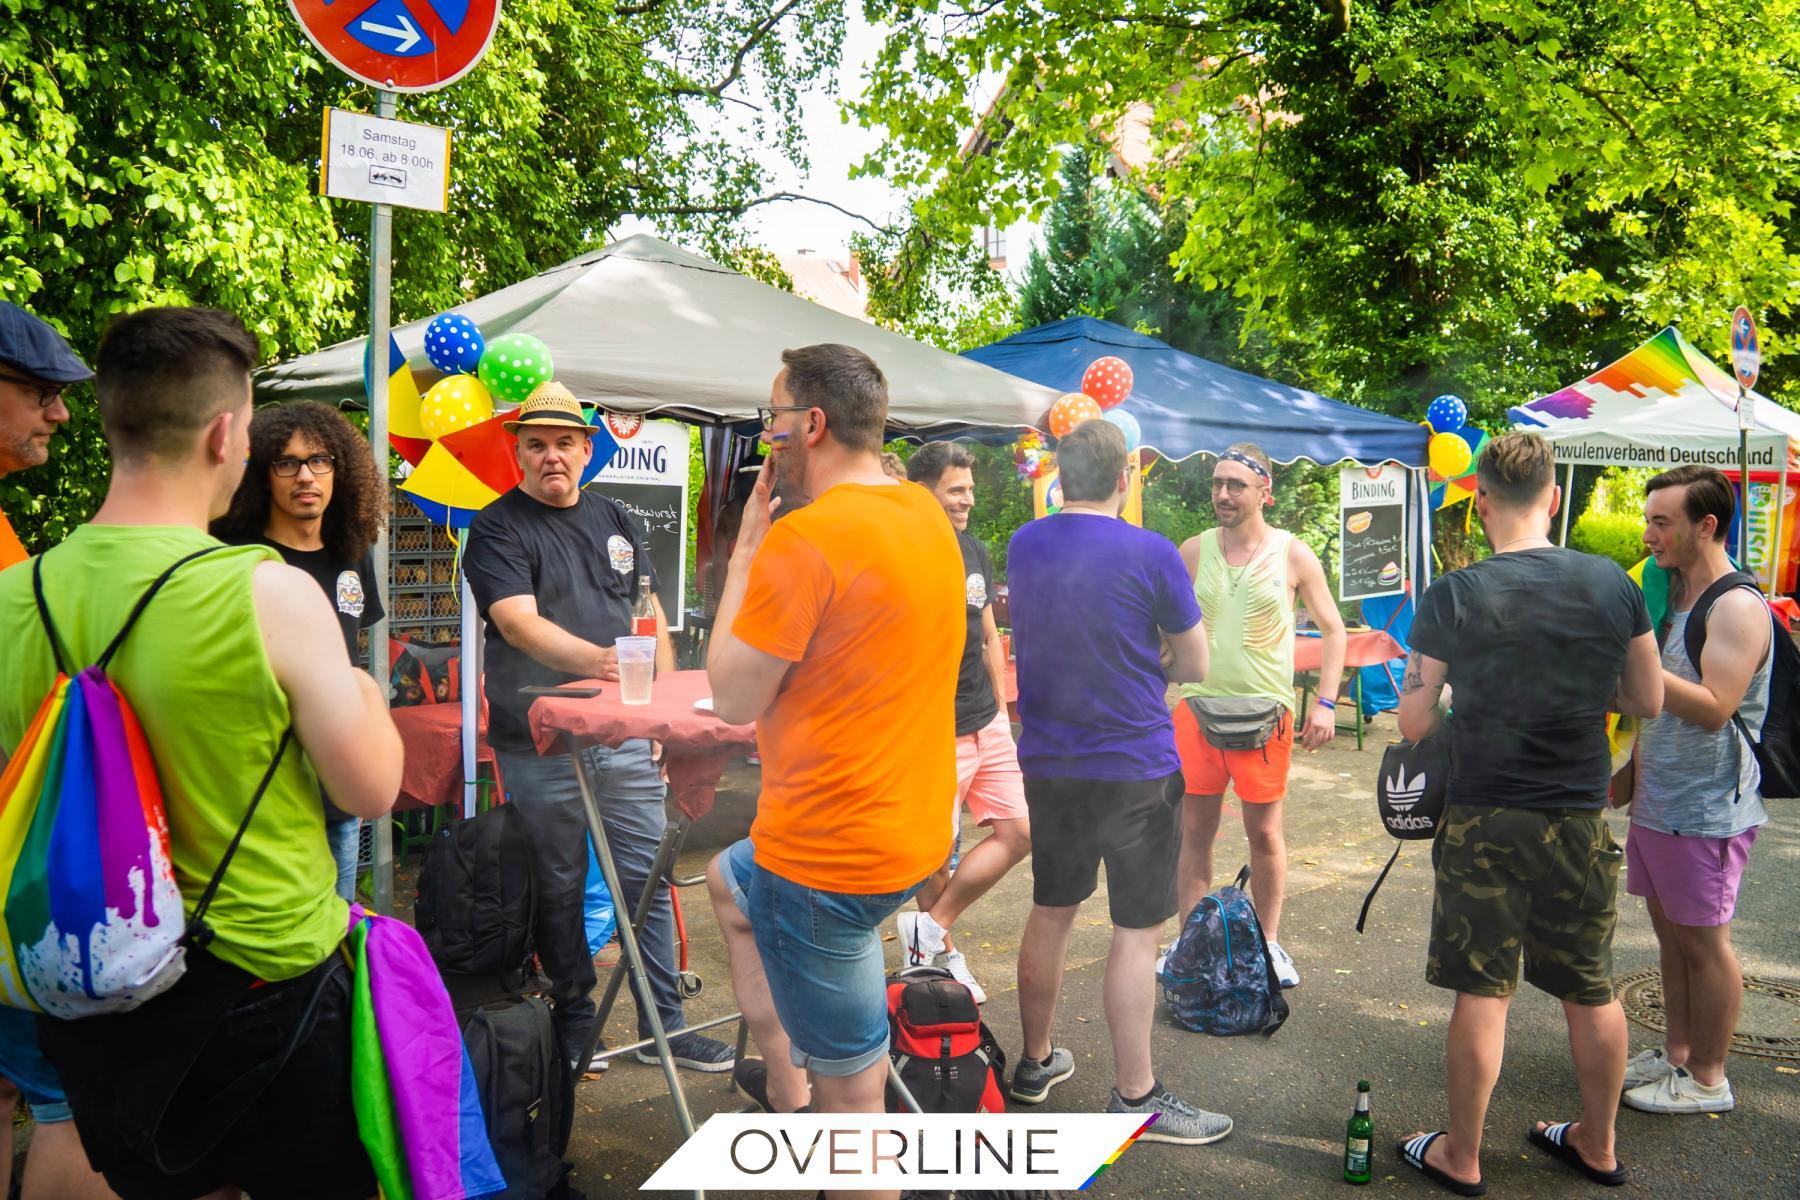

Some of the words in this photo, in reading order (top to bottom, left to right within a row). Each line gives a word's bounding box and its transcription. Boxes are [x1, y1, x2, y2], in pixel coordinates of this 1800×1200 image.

[363, 128, 416, 150] Samstag
[340, 143, 378, 161] 18.06.
[382, 152, 397, 163] ab
[609, 445, 667, 473] DING
[1553, 441, 1665, 463] hwulenverband
[1670, 446, 1773, 465] Deutschlnd
[1352, 480, 1395, 500] BINDING
[1386, 814, 1433, 830] adidas
